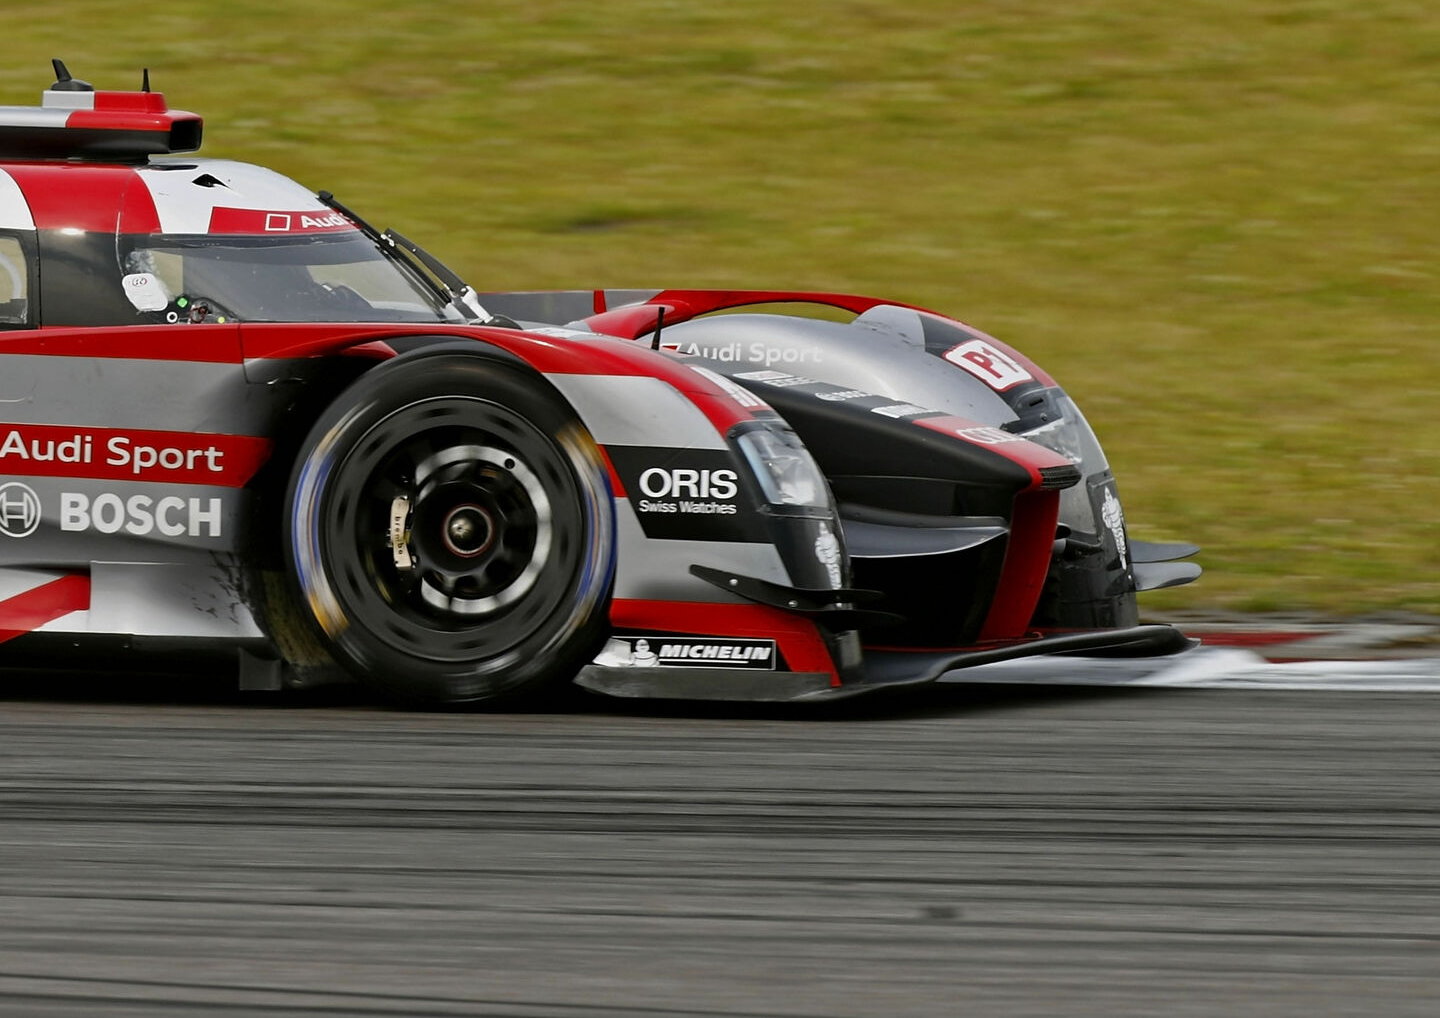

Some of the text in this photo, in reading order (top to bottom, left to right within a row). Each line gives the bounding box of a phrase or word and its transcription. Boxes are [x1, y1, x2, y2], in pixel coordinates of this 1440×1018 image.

[687, 342, 824, 367] Audi Sport
[961, 346, 1020, 379] P1
[106, 436, 224, 475] Sport
[638, 467, 739, 499] ORIS
[60, 492, 223, 537] BOSCH
[638, 499, 738, 515] Swiss Watches
[658, 644, 772, 661] MICHELIN
